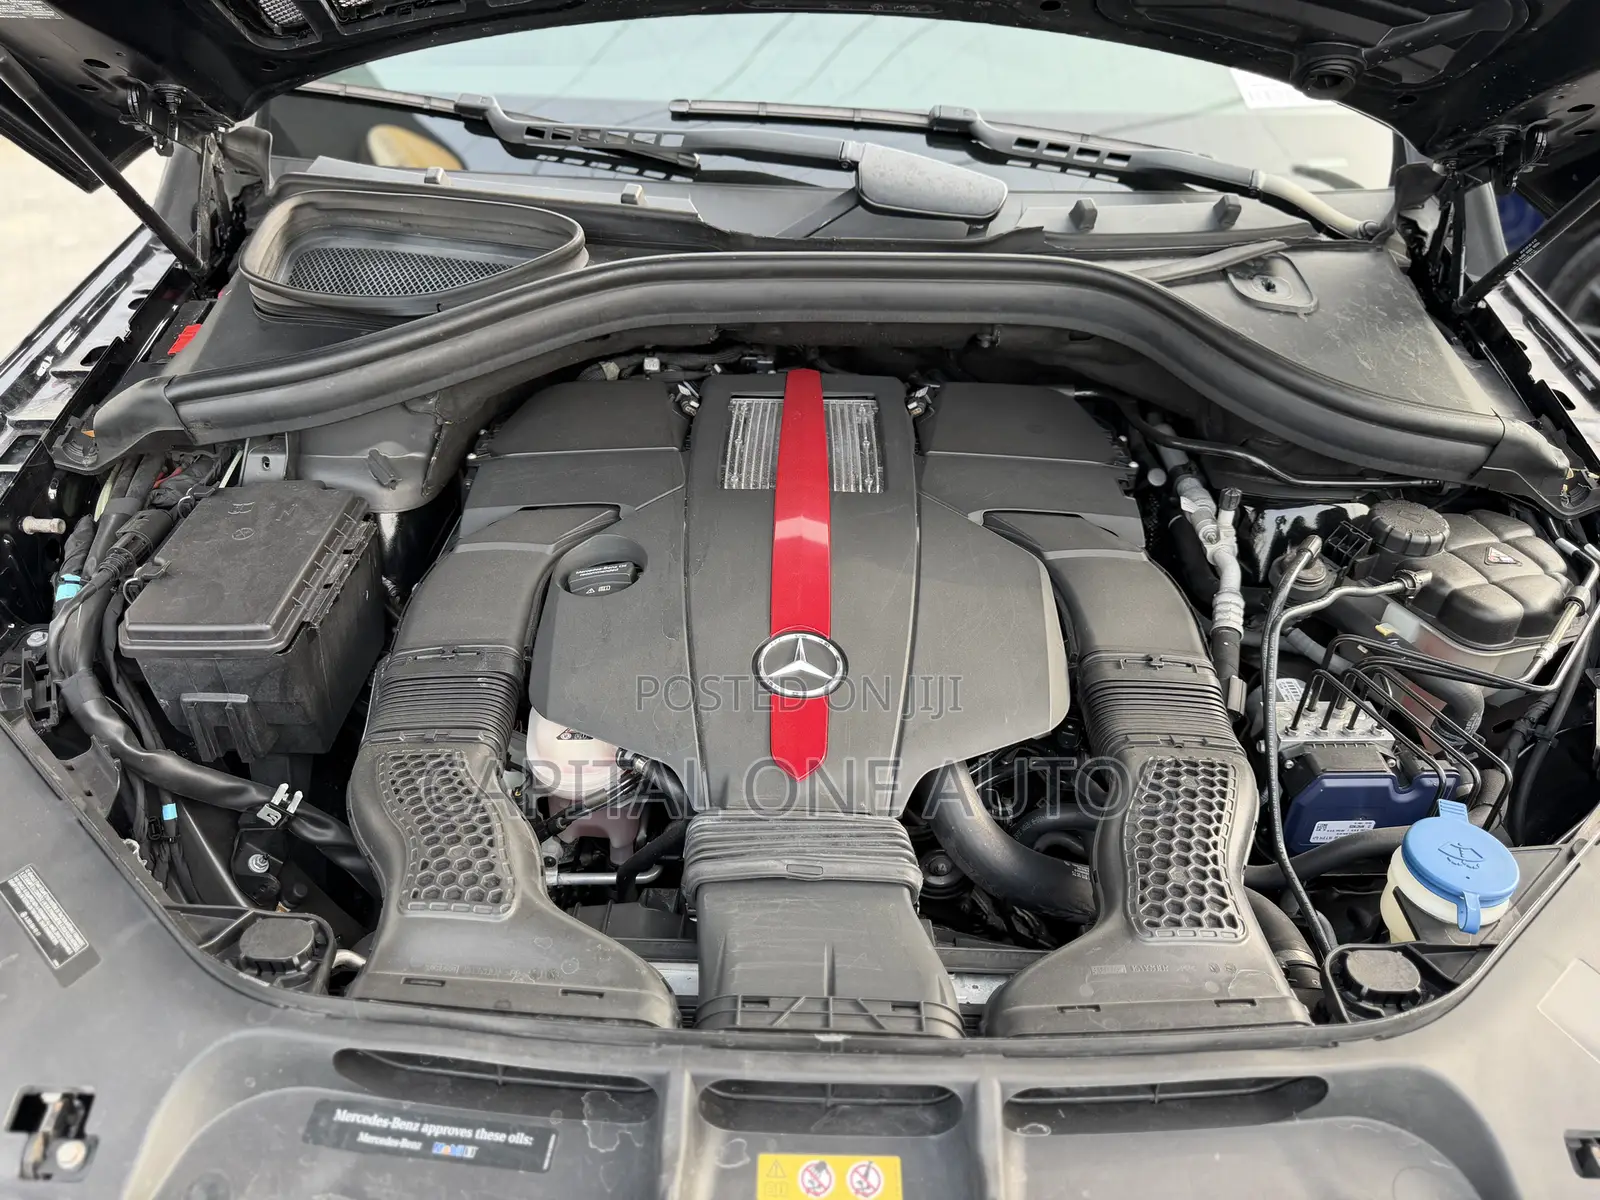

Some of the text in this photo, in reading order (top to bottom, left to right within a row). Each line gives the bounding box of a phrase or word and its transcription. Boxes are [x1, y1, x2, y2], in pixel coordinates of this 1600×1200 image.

[333, 1108, 534, 1146] Mercedes-Benz approves these oils:
[357, 1131, 422, 1151] Mercedes-Benz
